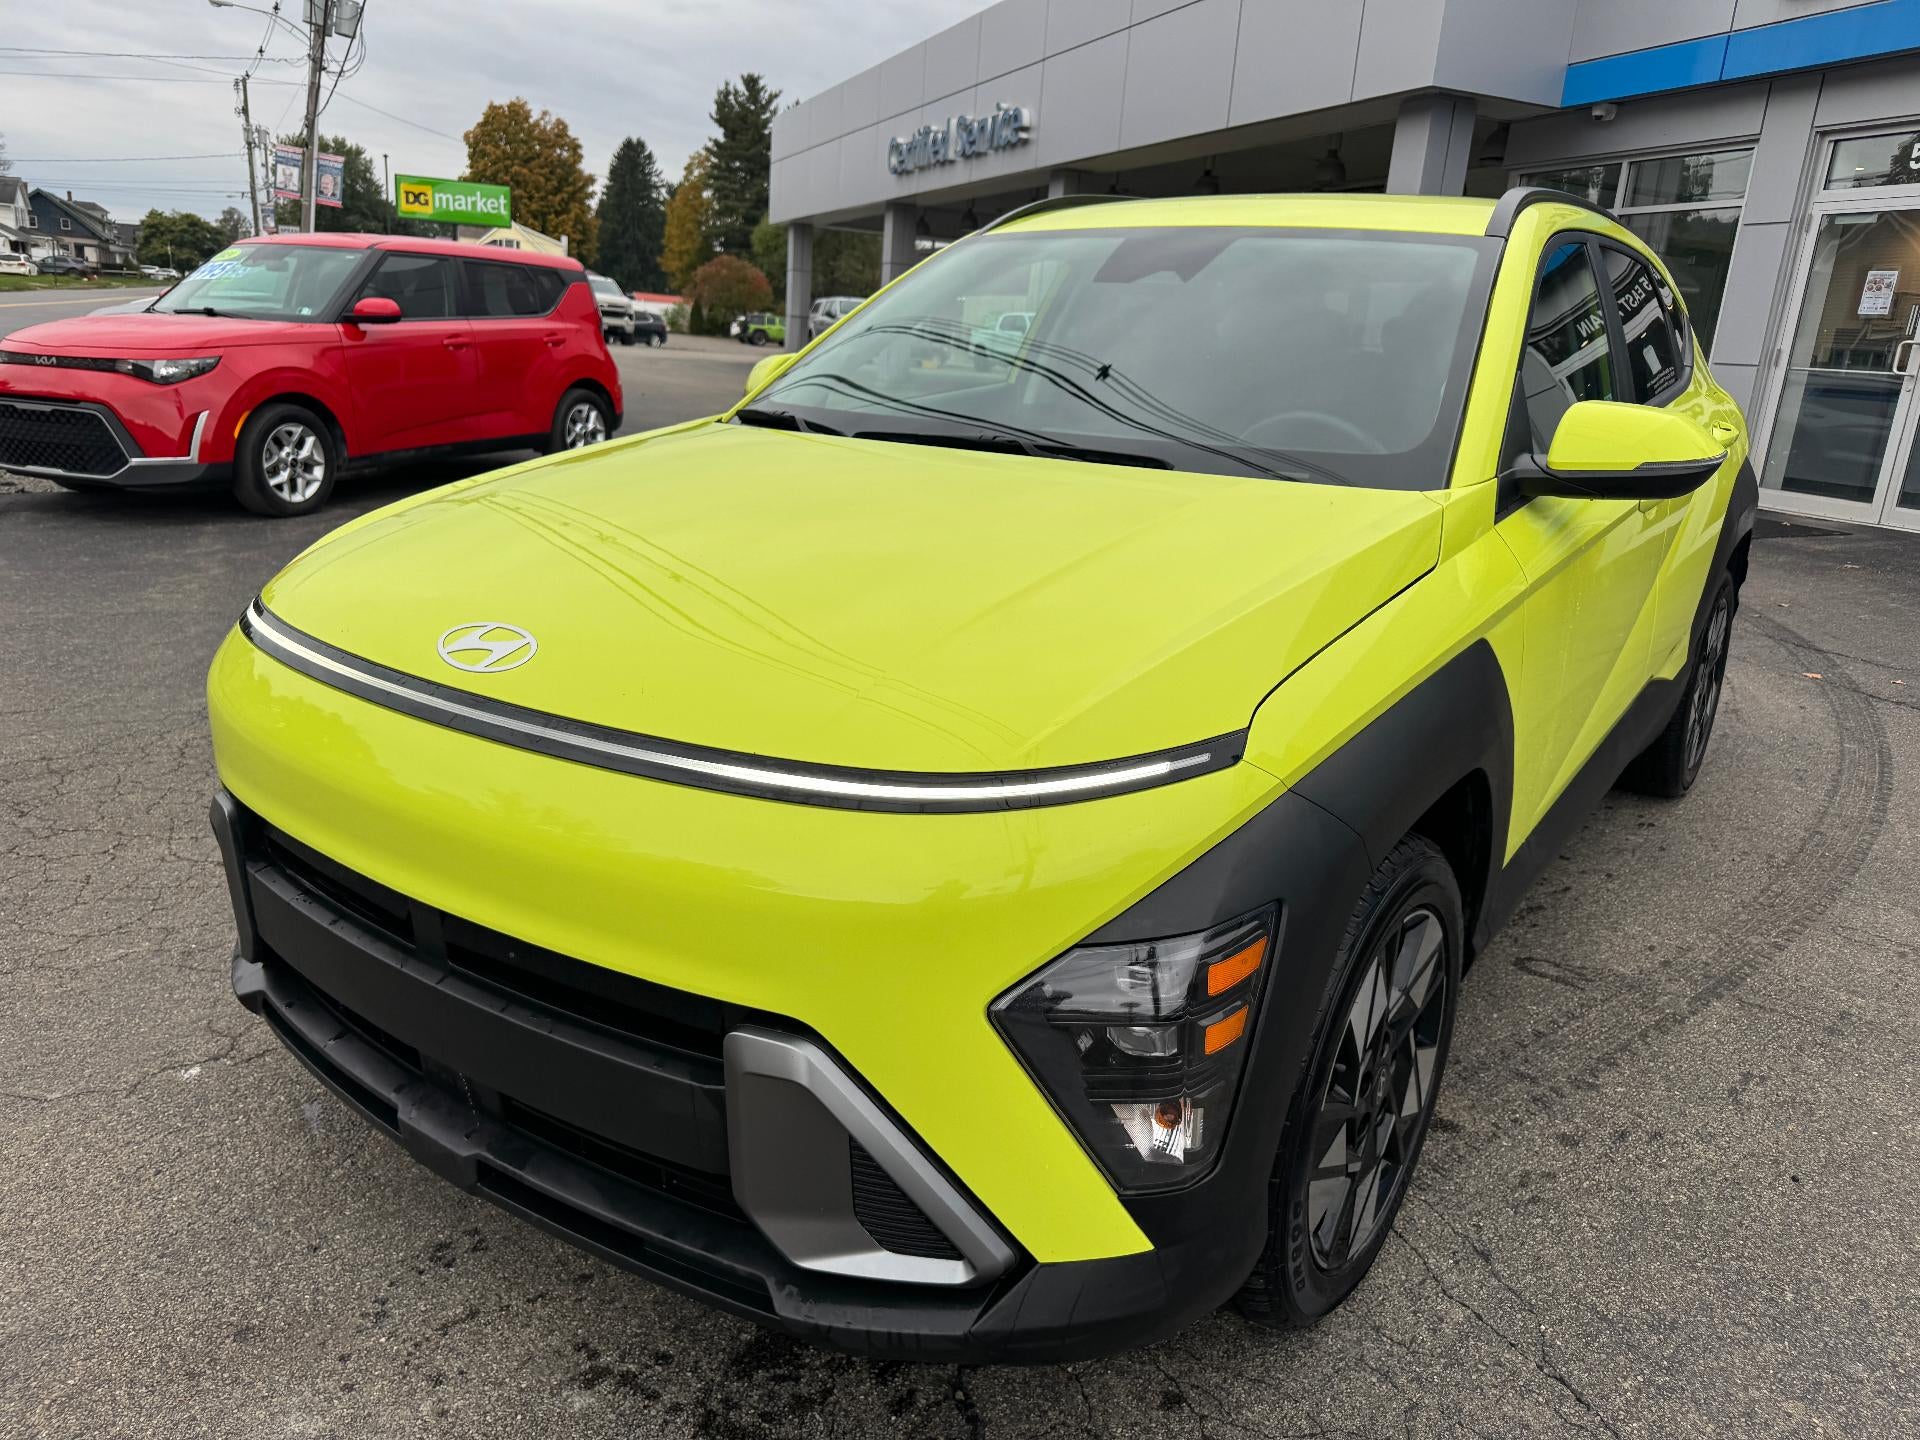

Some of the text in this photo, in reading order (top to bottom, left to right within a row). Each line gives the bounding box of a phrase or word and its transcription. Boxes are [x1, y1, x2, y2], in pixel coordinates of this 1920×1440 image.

[888, 102, 1031, 175] Certified Service
[403, 189, 507, 216] DG market
[35, 355, 57, 365] KIA
